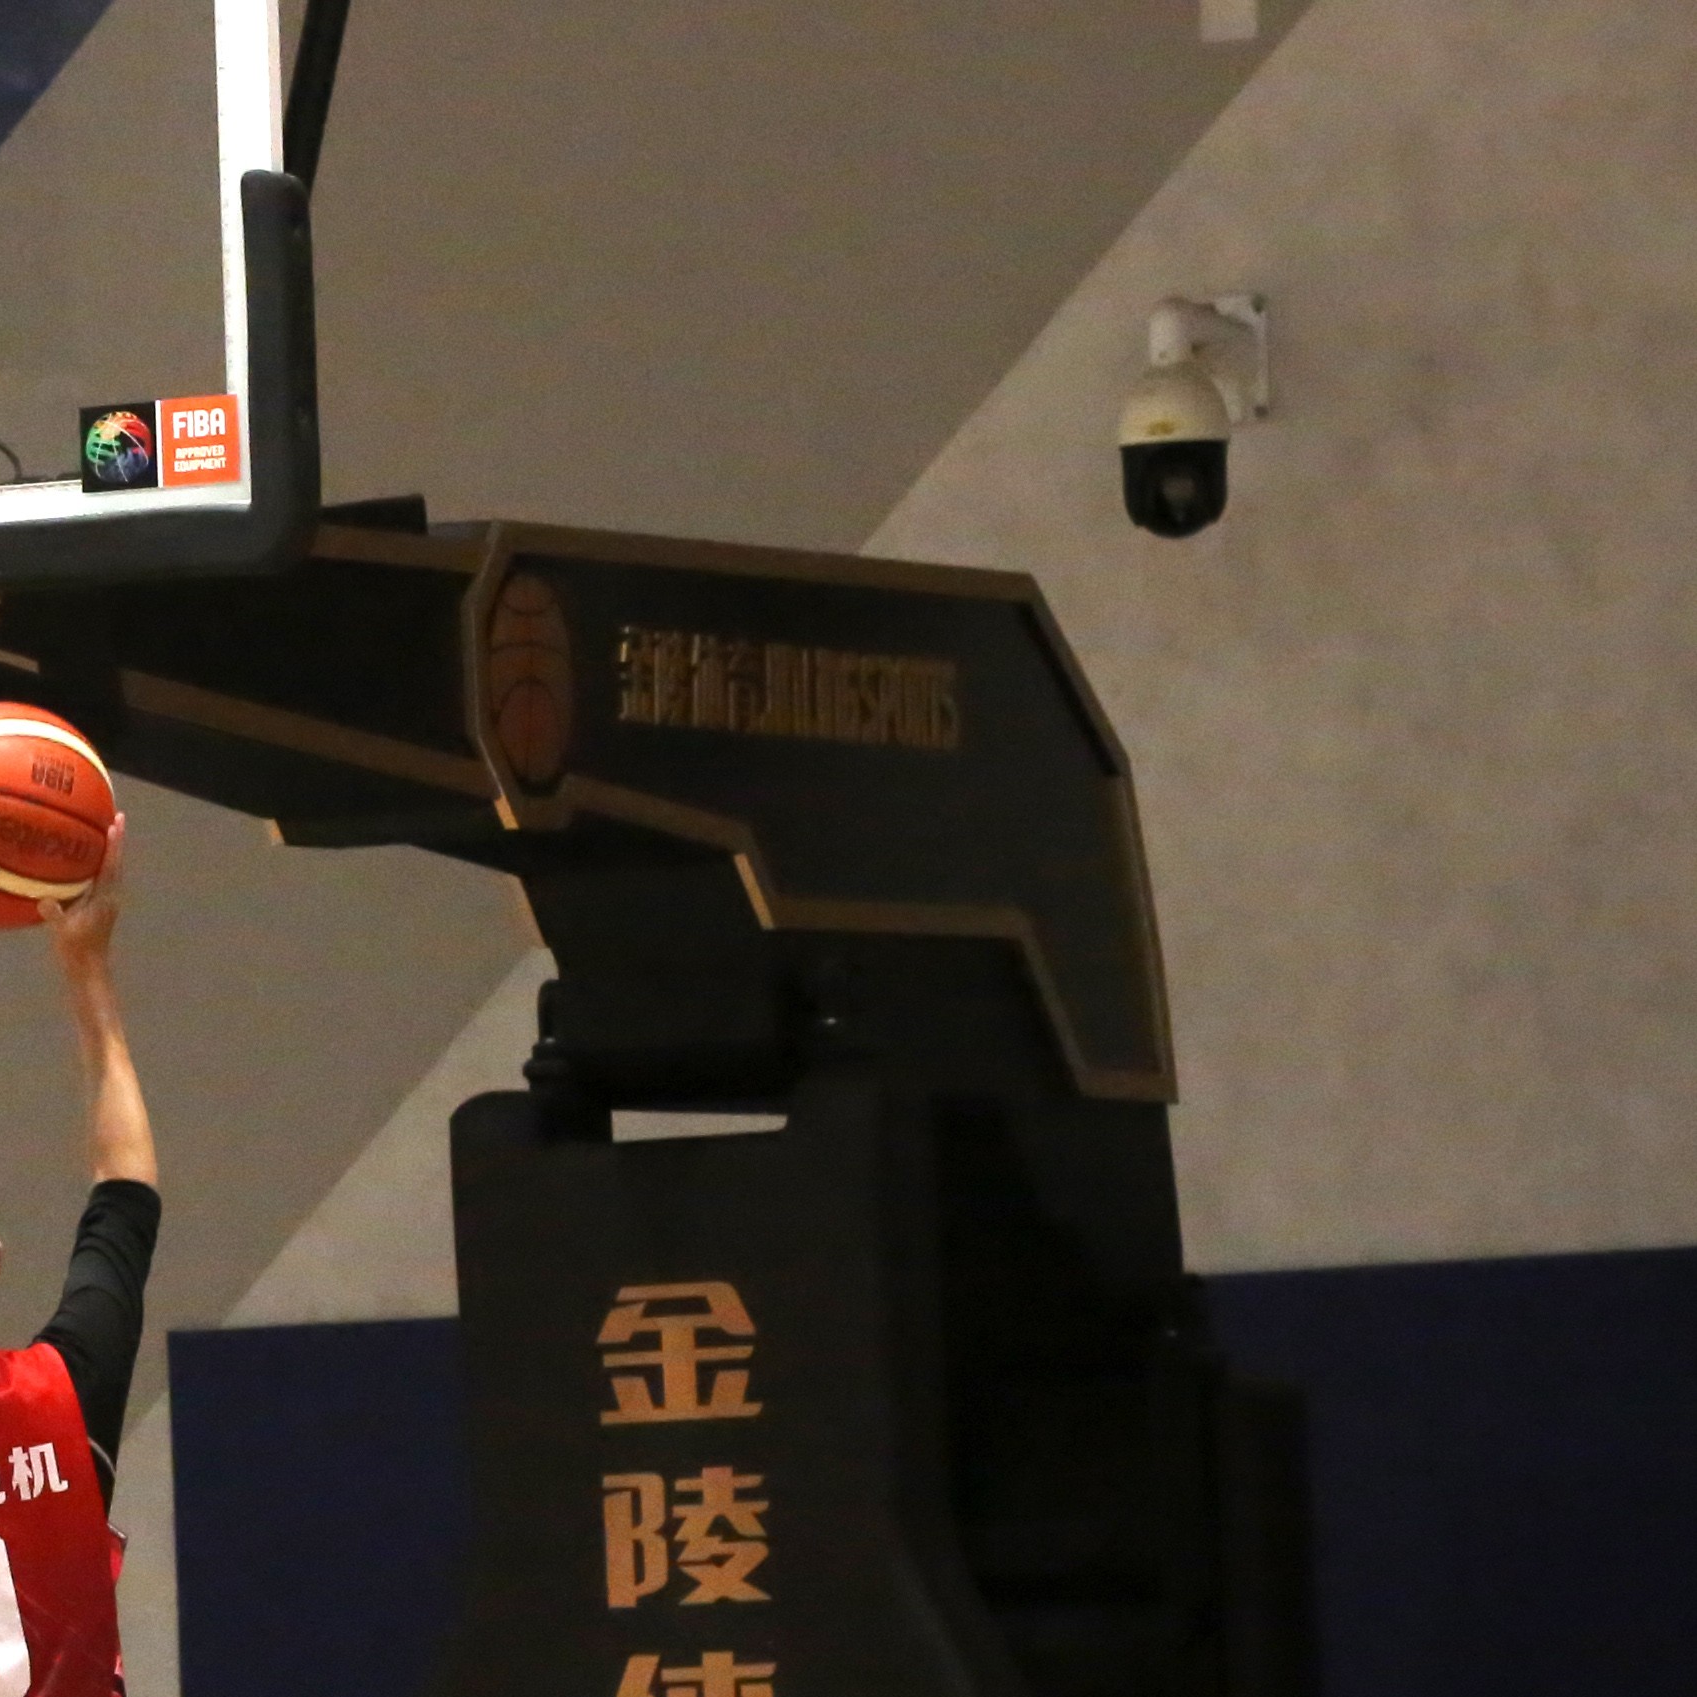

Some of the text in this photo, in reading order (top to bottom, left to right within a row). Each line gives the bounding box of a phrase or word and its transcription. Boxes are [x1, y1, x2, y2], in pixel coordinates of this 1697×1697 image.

[172, 408, 227, 439] FIBA
[175, 444, 225, 460] APPROVED
[173, 457, 227, 473] EQUIPMENT
[31, 761, 75, 796] FIBA
